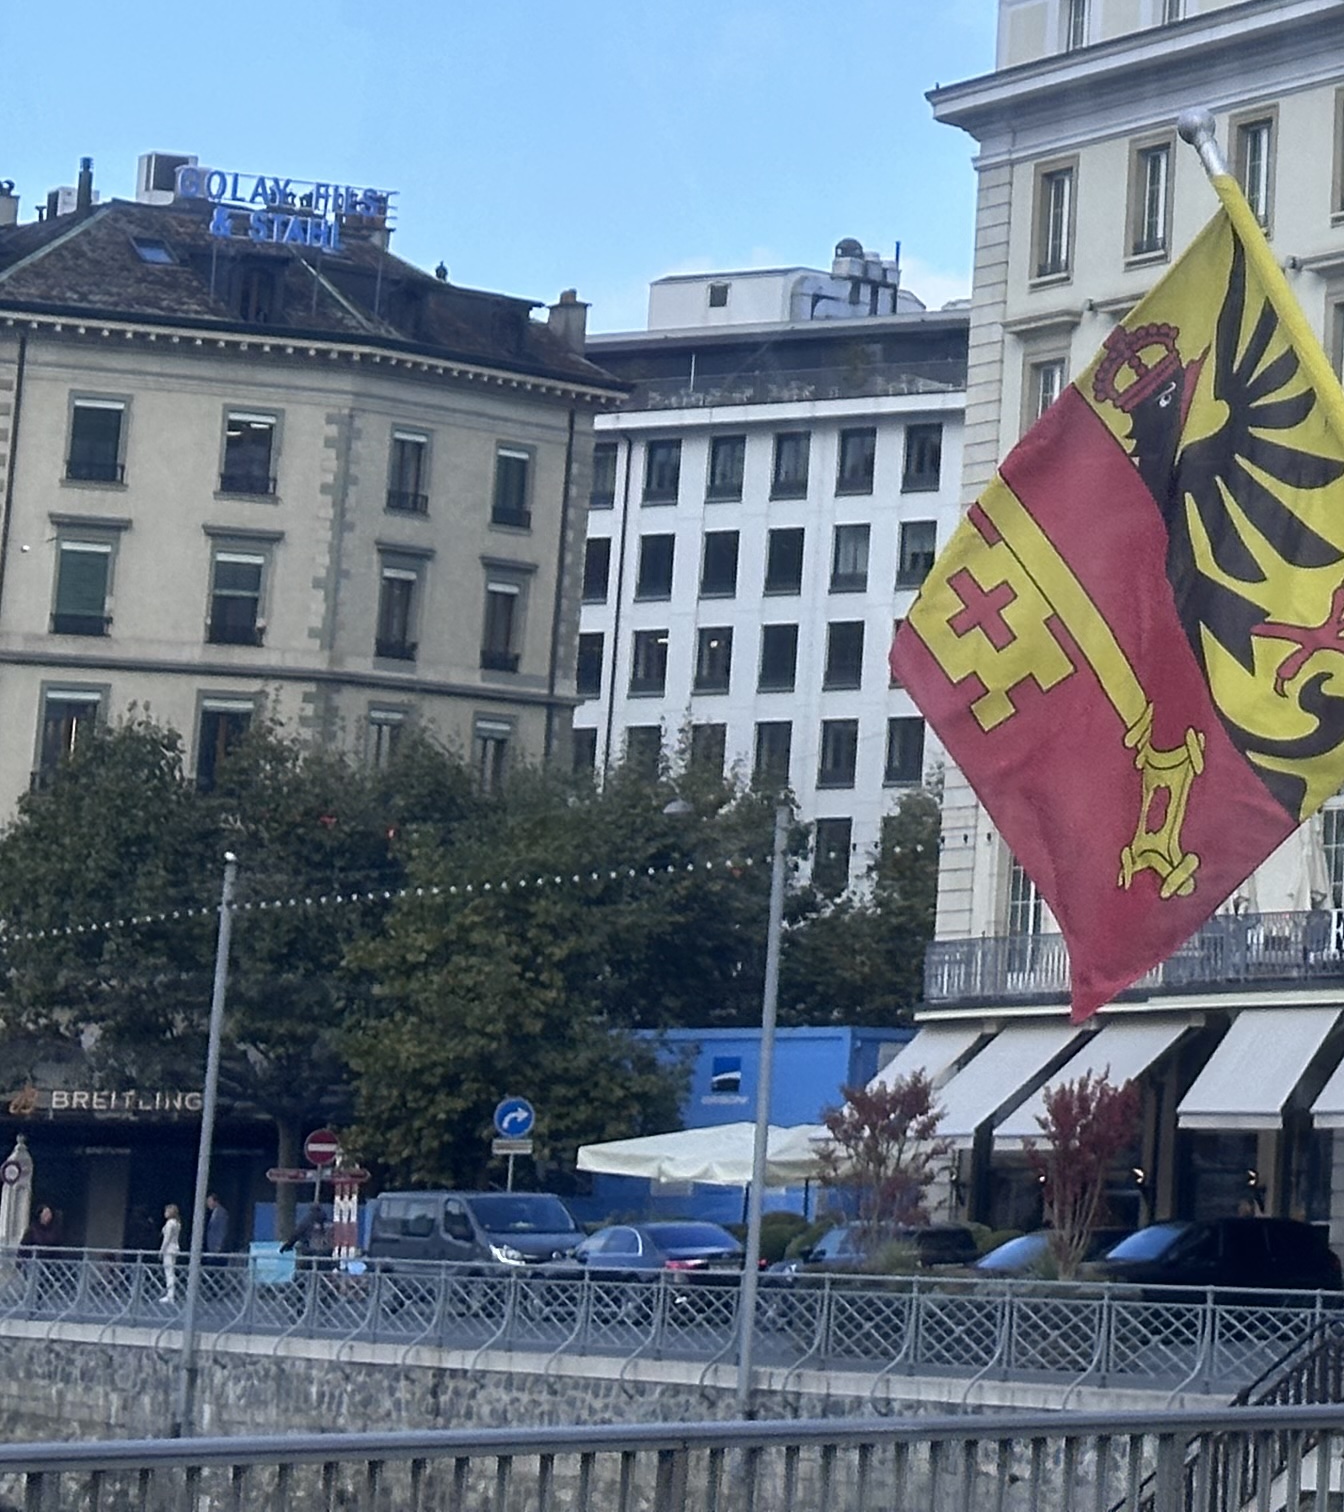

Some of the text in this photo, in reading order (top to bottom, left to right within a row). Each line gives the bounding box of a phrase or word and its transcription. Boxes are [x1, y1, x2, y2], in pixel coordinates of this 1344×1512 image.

[178, 168, 291, 206] GOLAY
[209, 206, 231, 237] &
[51, 1090, 202, 1111] BREITLING
